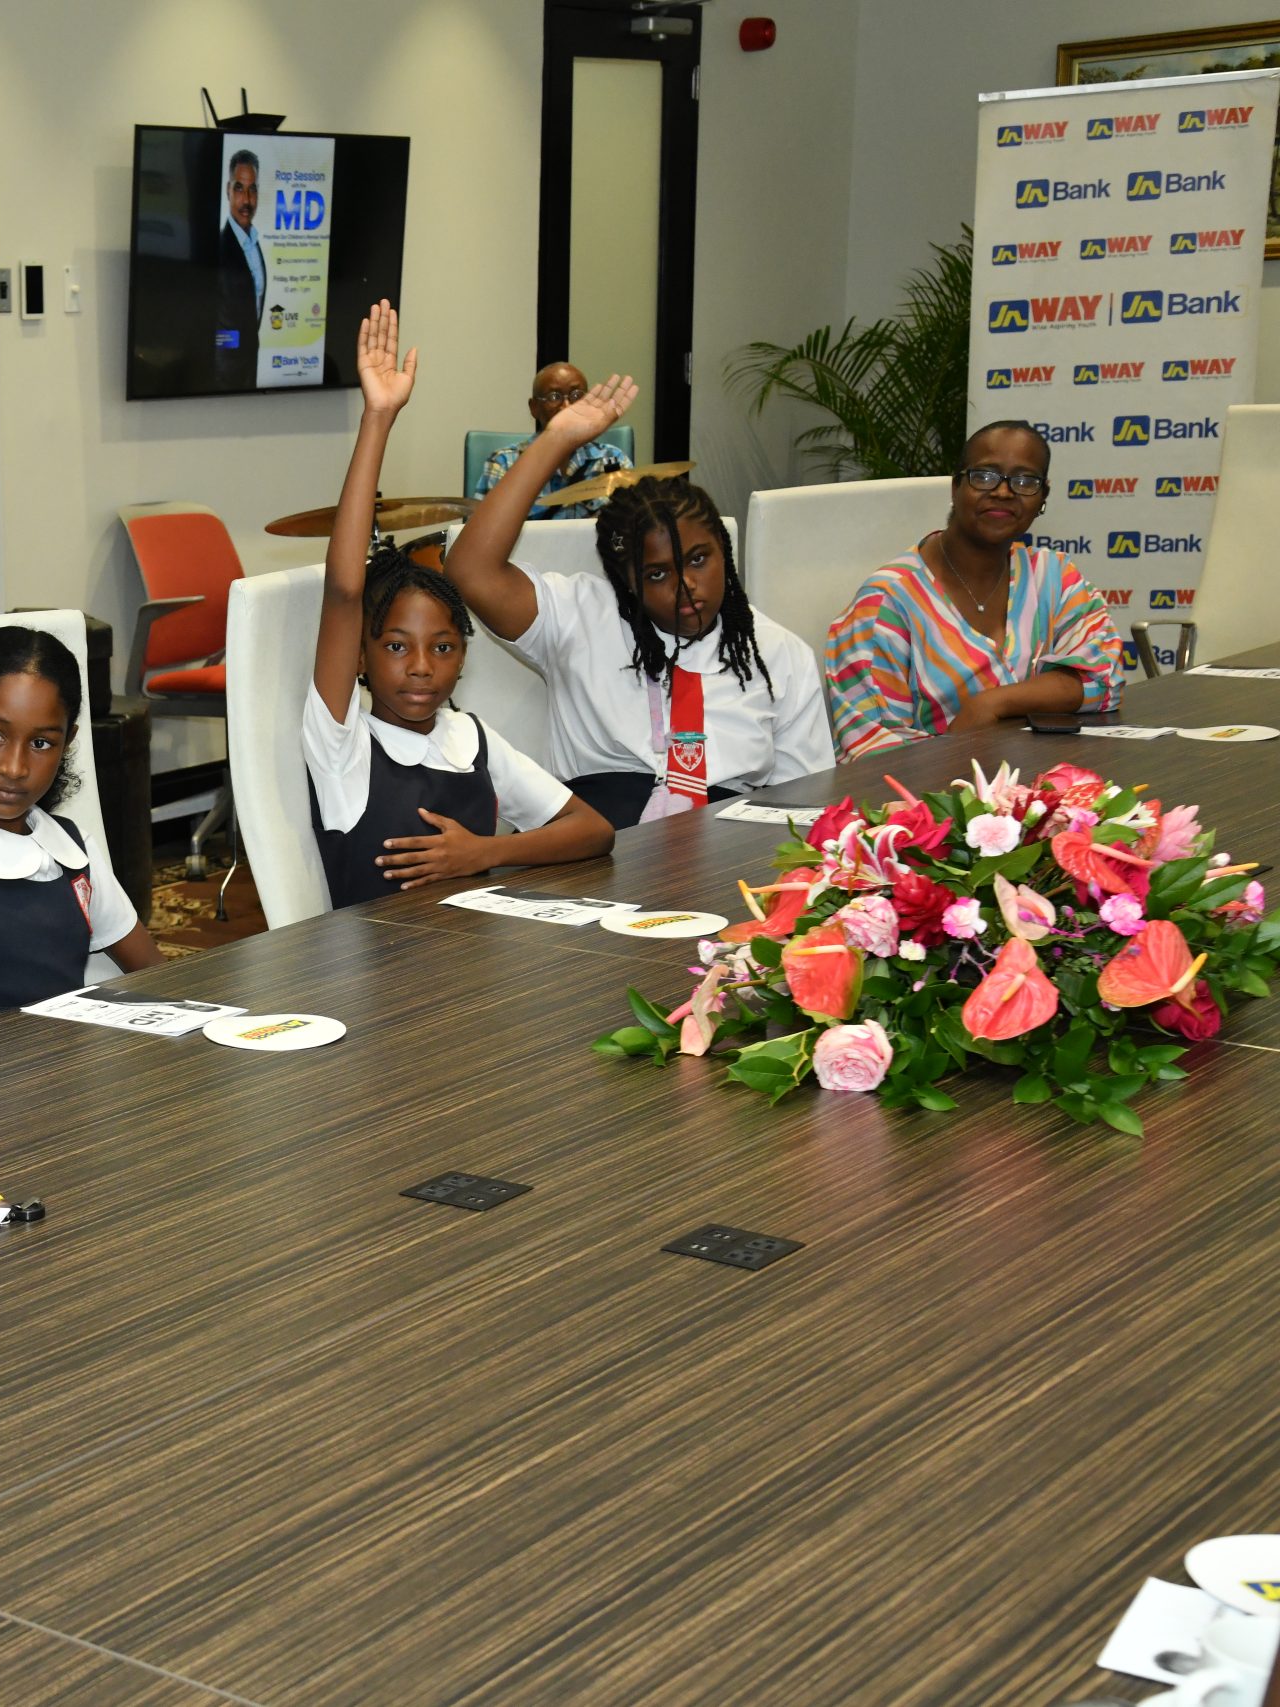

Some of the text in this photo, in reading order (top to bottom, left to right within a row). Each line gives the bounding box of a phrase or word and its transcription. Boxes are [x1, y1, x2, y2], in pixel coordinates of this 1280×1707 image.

[1113, 114, 1161, 132] WAY
[1206, 106, 1254, 126] WAY
[1024, 121, 1068, 140] WAY
[294, 170, 326, 182] Session
[1166, 170, 1226, 193] Bank
[1053, 179, 1111, 201] Bank
[275, 190, 325, 230] MD
[1106, 235, 1152, 253] WAY
[1197, 229, 1245, 248] WAY
[1017, 241, 1062, 259] WAY
[1030, 294, 1103, 323] WAY
[1168, 291, 1240, 316] Bank
[1012, 366, 1056, 383] WAY
[1099, 362, 1145, 380] WAY
[1189, 358, 1236, 376] WAY
[1154, 418, 1218, 440] Bank
[1094, 478, 1138, 494] WAY
[1145, 534, 1202, 552] Bank
